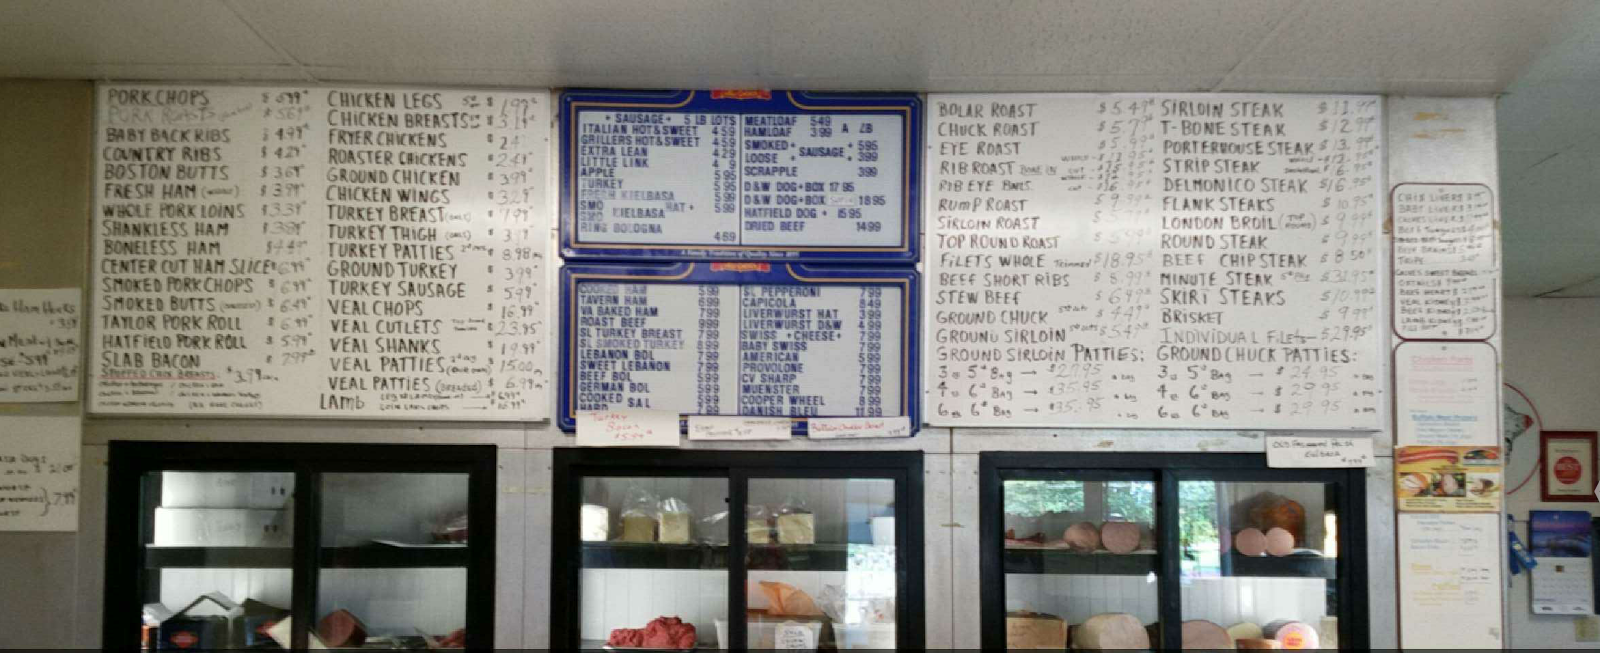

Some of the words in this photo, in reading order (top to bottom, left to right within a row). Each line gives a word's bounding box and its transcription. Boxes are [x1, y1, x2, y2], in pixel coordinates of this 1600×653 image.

[108, 89, 151, 105] PORK
[156, 89, 209, 106] CHOPS
[403, 93, 442, 109] LEGS
[937, 102, 983, 118] BOLAR
[991, 104, 1038, 117] ROAST
[1231, 102, 1284, 118] STEAK
[405, 112, 468, 129] BREASTS
[615, 115, 664, 123] SAUSAGE
[695, 116, 706, 124] LB
[712, 116, 736, 125] LOTS
[745, 117, 797, 126] MEATLOAF
[106, 128, 145, 142] BABY
[151, 128, 190, 142] BACK
[194, 129, 230, 143] RIBS
[583, 124, 627, 133] ITALIAN
[744, 128, 791, 137] HAMLOAF
[937, 123, 987, 137] CHUCK
[993, 122, 1039, 137] ROAST
[1161, 120, 1226, 136] T-BONE
[1231, 123, 1286, 137] STEAK
[329, 129, 374, 145] FRYER
[581, 136, 632, 145] GRILLERS
[581, 146, 616, 155] EXTRA
[621, 148, 648, 156] LEAN
[745, 141, 788, 150] SMOKED
[799, 148, 844, 157] SAUSAGE
[939, 142, 969, 156] EYE
[977, 143, 1021, 155] ROAST
[1164, 141, 1264, 155] PORTERHOUSE
[1267, 141, 1314, 155] STEAK
[102, 147, 176, 161] COUNTRY
[182, 148, 221, 161] RIBS
[329, 148, 393, 165] ROASTER
[745, 154, 778, 163] LOOSE
[581, 158, 617, 167] LITTLE
[623, 158, 649, 167] LINK
[939, 162, 968, 175] RIB
[972, 162, 1015, 175] ROAST
[1215, 159, 1260, 173] STEAK
[104, 164, 171, 180] BOSTON
[176, 166, 228, 180] BUTTS
[327, 168, 388, 183] GROUND
[581, 169, 614, 177] APPLE
[744, 167, 798, 176] SCRAPPLE
[581, 179, 623, 188] TURKEY
[968, 180, 994, 192] EYE
[1164, 177, 1255, 192] DELMONICO
[1261, 178, 1308, 193] STEAK
[104, 184, 154, 199] FRESH
[163, 185, 196, 199] HAM
[102, 204, 153, 218] WHOLE
[160, 204, 196, 218] PORK
[201, 205, 244, 218] LOINS
[985, 198, 1028, 212] ROAST
[1162, 197, 1215, 212] FLANK
[1219, 197, 1275, 212] STEAKS
[328, 205, 383, 221] TURKEY
[390, 206, 445, 222] BREAST
[745, 208, 791, 218] HATFIELD
[797, 208, 817, 218] DOG
[102, 222, 188, 237] SHANKLESS
[195, 223, 228, 236] HAM
[780, 222, 805, 231] BEEF
[996, 216, 1040, 230] ROAST
[1162, 216, 1223, 230] LONDON
[328, 225, 385, 241] TURKEY
[103, 240, 177, 255] BONELESS
[187, 242, 220, 256] HAM
[937, 233, 965, 249] TOP
[970, 235, 1019, 249] ROUND
[1023, 236, 1060, 248] ROAST
[1161, 234, 1215, 249] ROUND
[1220, 235, 1268, 249] STEAK
[328, 243, 387, 258] TURKEY
[101, 259, 157, 274] CENTER
[162, 260, 189, 273] CUT
[193, 260, 225, 274] HAM
[1000, 254, 1045, 267] WHOLE
[1163, 254, 1204, 267] BEEF
[1259, 254, 1307, 268] STEAK
[327, 261, 395, 277] GROUND
[400, 262, 457, 279] TURKEY
[102, 278, 162, 292] SMOKED
[167, 276, 200, 292] PORK
[203, 278, 253, 293] CHOPS
[939, 273, 976, 286] BEEF
[983, 273, 1029, 287] SHORT
[1160, 272, 1216, 286] MINUTE
[1226, 271, 1273, 286] STEAK
[328, 279, 391, 295] TURKEY
[397, 282, 465, 298] SAUSAGE
[762, 288, 821, 297] PEPPERONI
[102, 297, 164, 312] SMOKED
[171, 296, 215, 312] BUTTS
[581, 295, 619, 304] TAVERN
[742, 298, 796, 308] CAPICOLA
[936, 291, 978, 304] STEW
[1219, 288, 1285, 306] STEAKS
[328, 299, 368, 315] VEAL
[373, 300, 423, 316] CHOPS
[597, 307, 631, 316] BAKED
[636, 307, 658, 316] HAM
[744, 309, 812, 318] LIVERWURST
[817, 310, 838, 318] HAT
[102, 315, 156, 330] TAYLOR
[163, 315, 201, 330] PORK
[207, 315, 242, 331] ROLL
[581, 317, 614, 326] ROAST
[621, 318, 647, 327] BEEF
[744, 320, 812, 329] LIVERWURST
[936, 311, 996, 324] GROUND
[1001, 311, 1048, 325] CHUCK
[331, 319, 369, 333] VEAL
[376, 319, 443, 334] CUTLETS
[596, 329, 636, 338] TURKEY
[641, 330, 682, 338] BREAST
[176, 334, 210, 349] PORK
[215, 335, 246, 349] ROLL
[742, 331, 777, 340] SWISS
[794, 332, 835, 341] CHEESE
[330, 338, 368, 352] VEAL
[375, 336, 440, 354] SHANKS
[742, 342, 768, 350] BABY
[772, 342, 807, 351] SWISS
[101, 352, 144, 368] SLAB
[151, 353, 200, 368] BACON
[581, 350, 628, 359] LEBANON
[742, 352, 799, 362] AMERICAN
[936, 347, 1002, 361] GROUND
[1157, 346, 1222, 361] GROUND
[1225, 348, 1275, 362] CHUCK
[330, 357, 371, 372] VEAL
[581, 361, 616, 370] SWEET
[622, 362, 671, 371] LEBANON
[743, 363, 803, 372] PROVOLONE
[761, 374, 797, 383] SHARP
[580, 383, 624, 392] GERMAN
[742, 385, 799, 394] MUENSTER
[742, 396, 783, 405] COOPER
[789, 396, 825, 405] WHEEL
